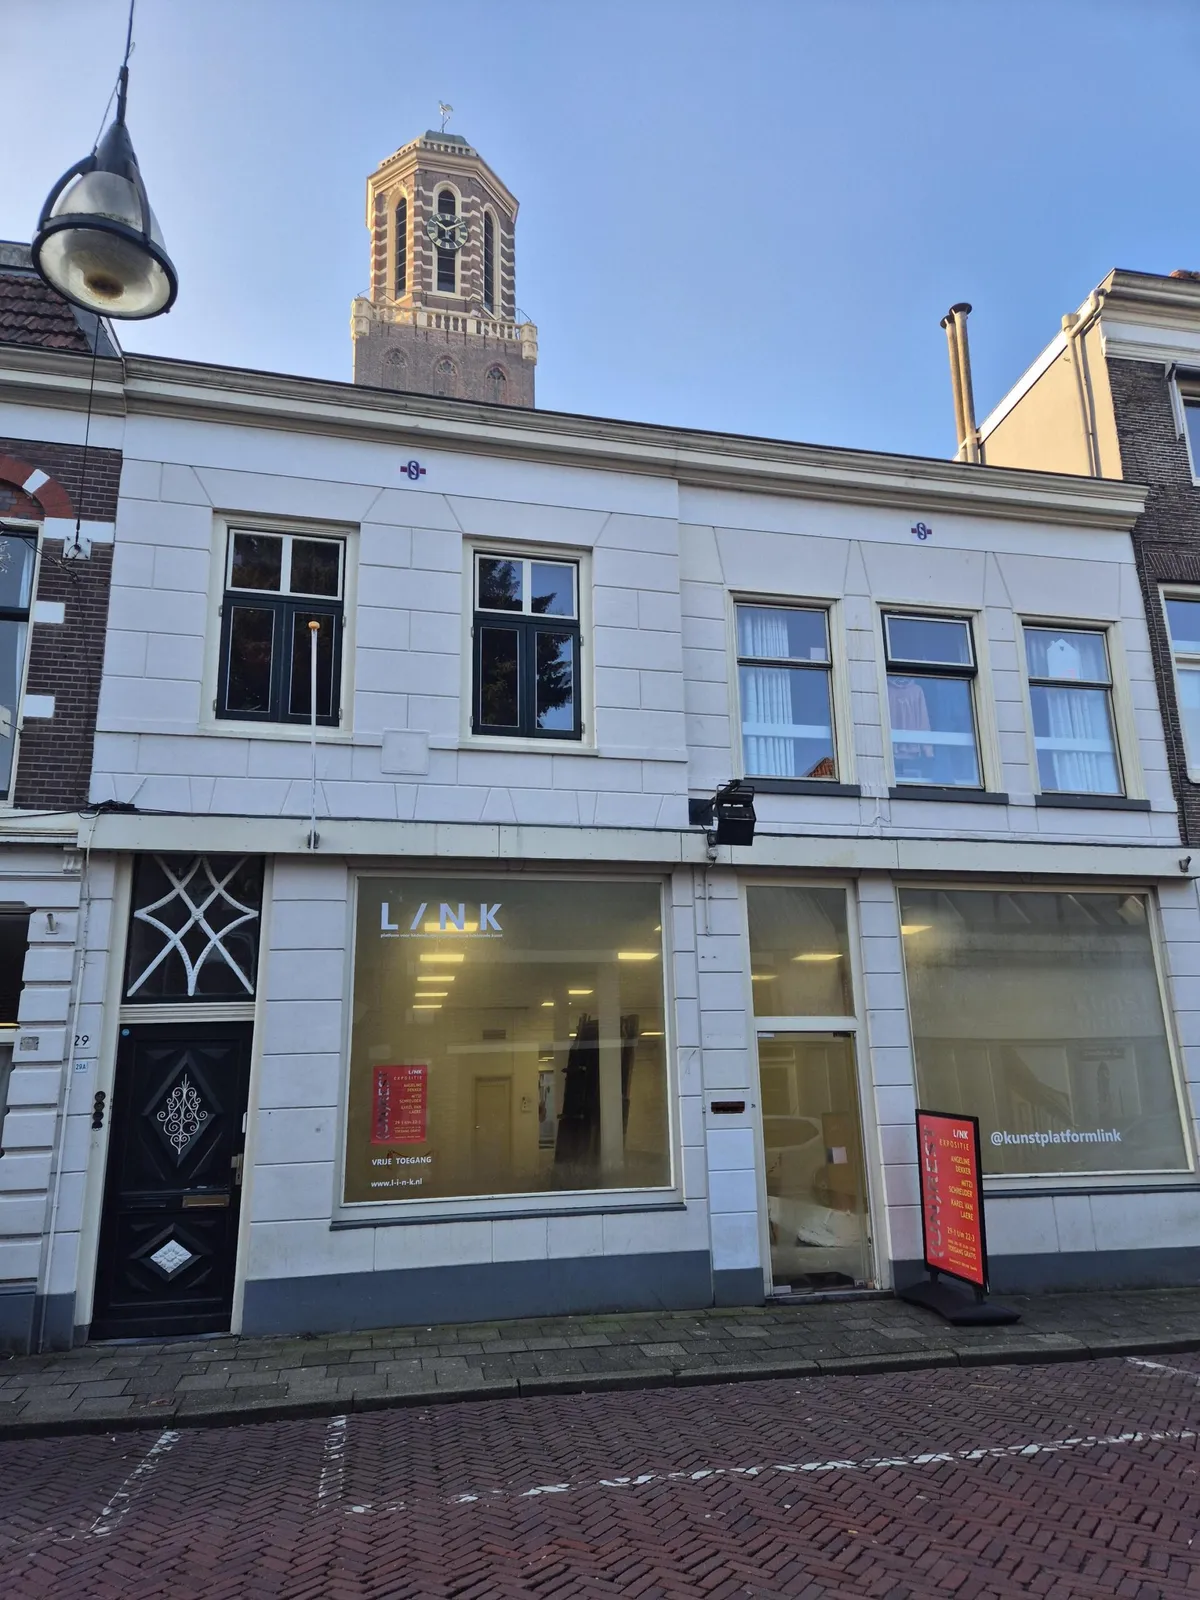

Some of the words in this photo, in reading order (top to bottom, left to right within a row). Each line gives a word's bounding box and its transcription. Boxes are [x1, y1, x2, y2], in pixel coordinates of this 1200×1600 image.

[74, 1035, 89, 1046] 29
[990, 1128, 1122, 1147] @kunstplatformlink
[939, 1138, 970, 1152] EXPOSITIE
[371, 1157, 392, 1166] VRIJE
[396, 1156, 432, 1165] TOEGANG
[955, 1165, 971, 1176] DEKKER
[370, 1178, 423, 1188] www.l-i-n-k.nl
[950, 1198, 965, 1209] KAREL
